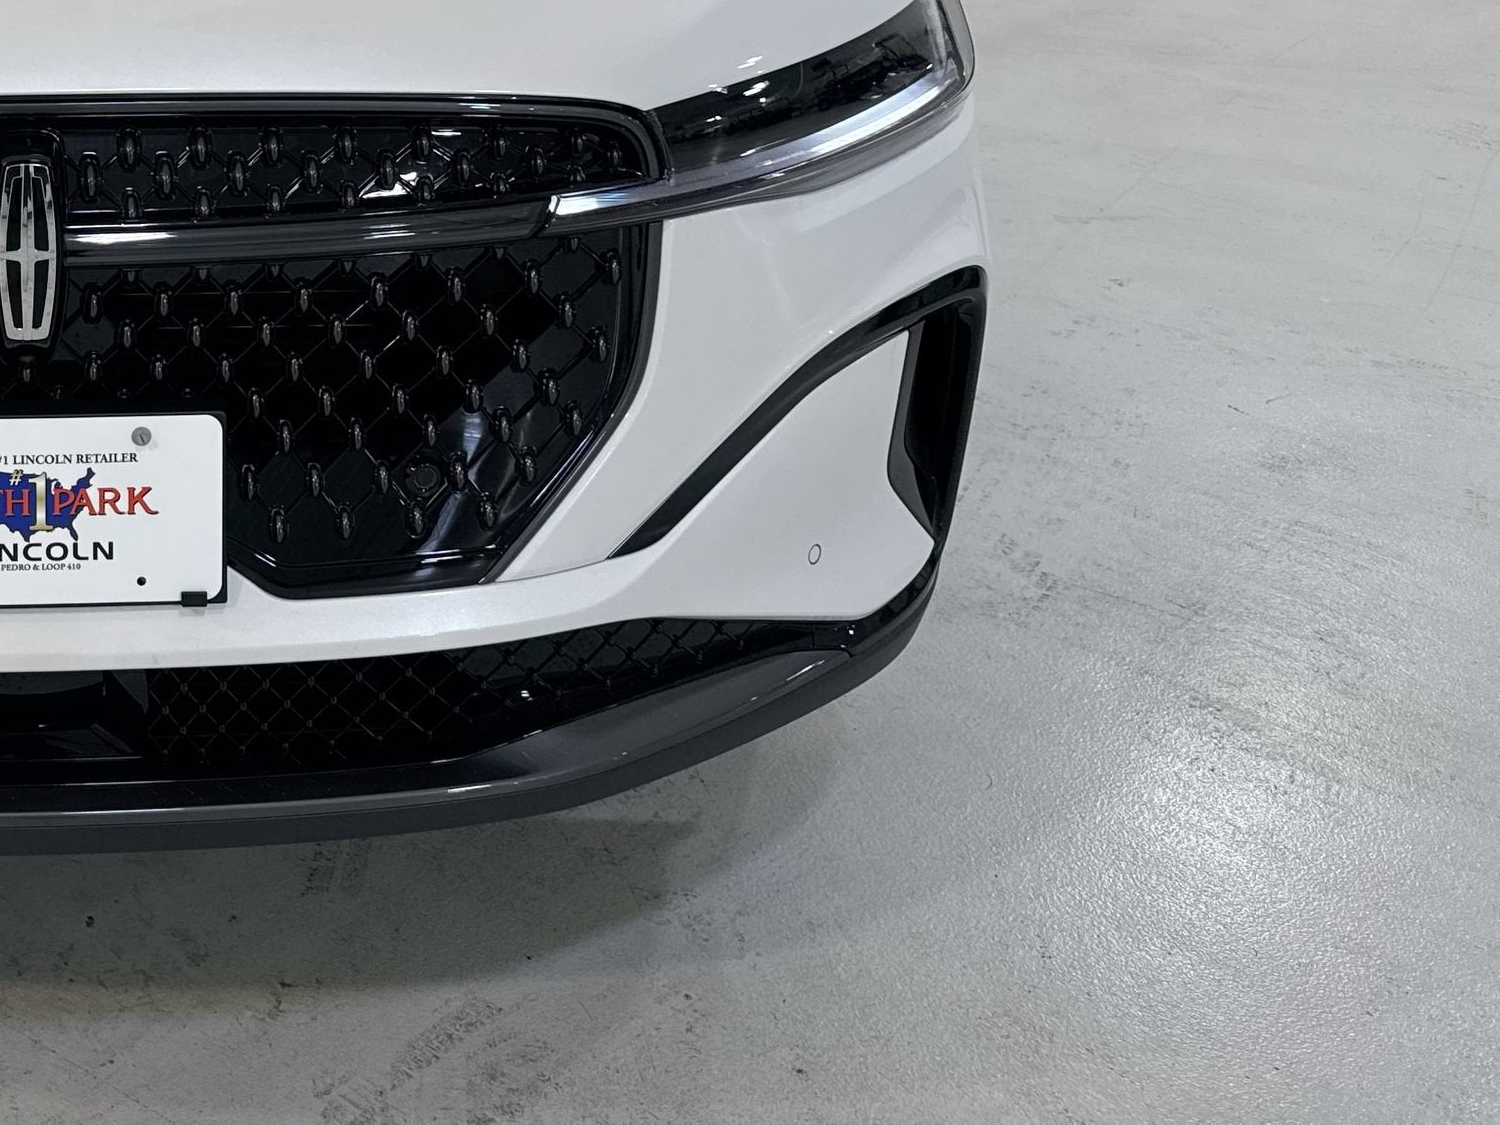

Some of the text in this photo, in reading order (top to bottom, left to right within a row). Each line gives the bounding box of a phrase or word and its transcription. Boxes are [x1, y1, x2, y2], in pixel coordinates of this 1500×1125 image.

[12, 453, 73, 466] LINCOLN
[75, 452, 138, 464] RETAILER
[52, 485, 159, 517] PARK
[1, 563, 31, 571] PEDRO
[32, 563, 40, 571] &
[41, 563, 66, 571] LOOP
